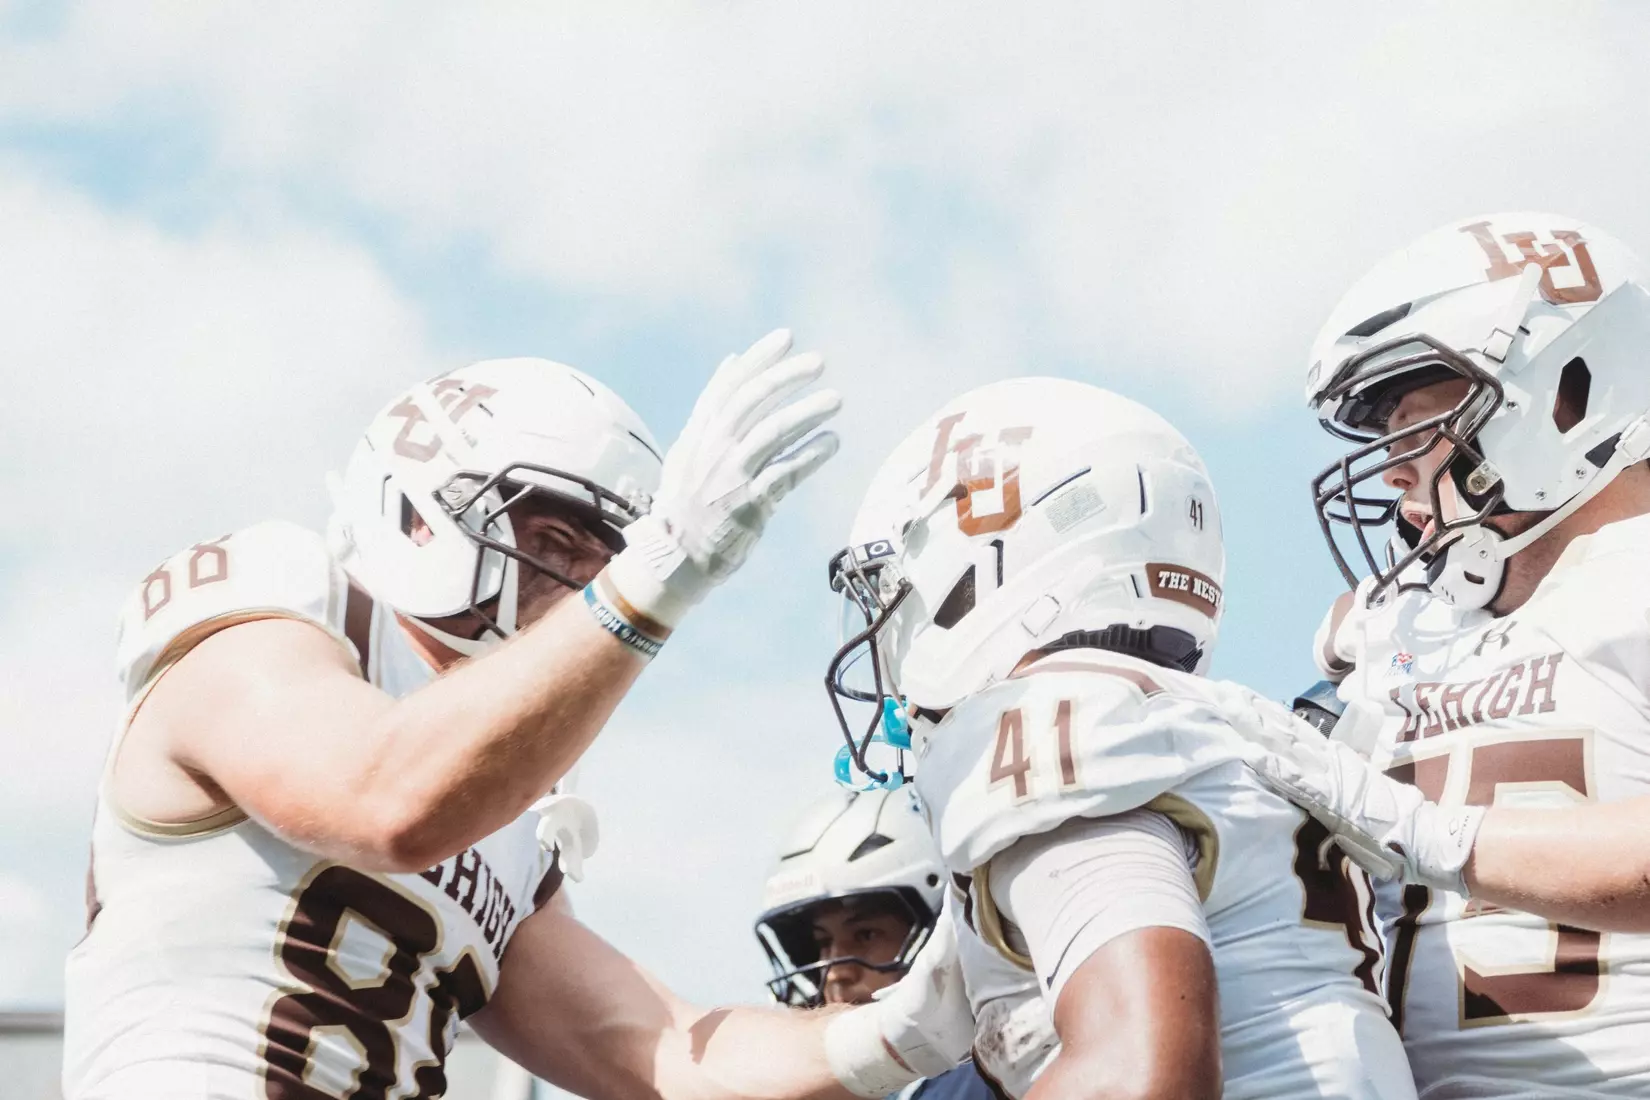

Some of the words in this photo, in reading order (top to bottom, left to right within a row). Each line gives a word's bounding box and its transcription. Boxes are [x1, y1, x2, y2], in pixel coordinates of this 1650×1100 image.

[1458, 220, 1607, 306] LU
[918, 410, 1034, 538] LU
[1187, 498, 1204, 531] 41
[1158, 570, 1190, 592] THE
[1191, 577, 1221, 608] NEST
[1389, 651, 1565, 735] LEHIGH
[987, 698, 1080, 800] 41
[417, 847, 516, 970] HIGH
